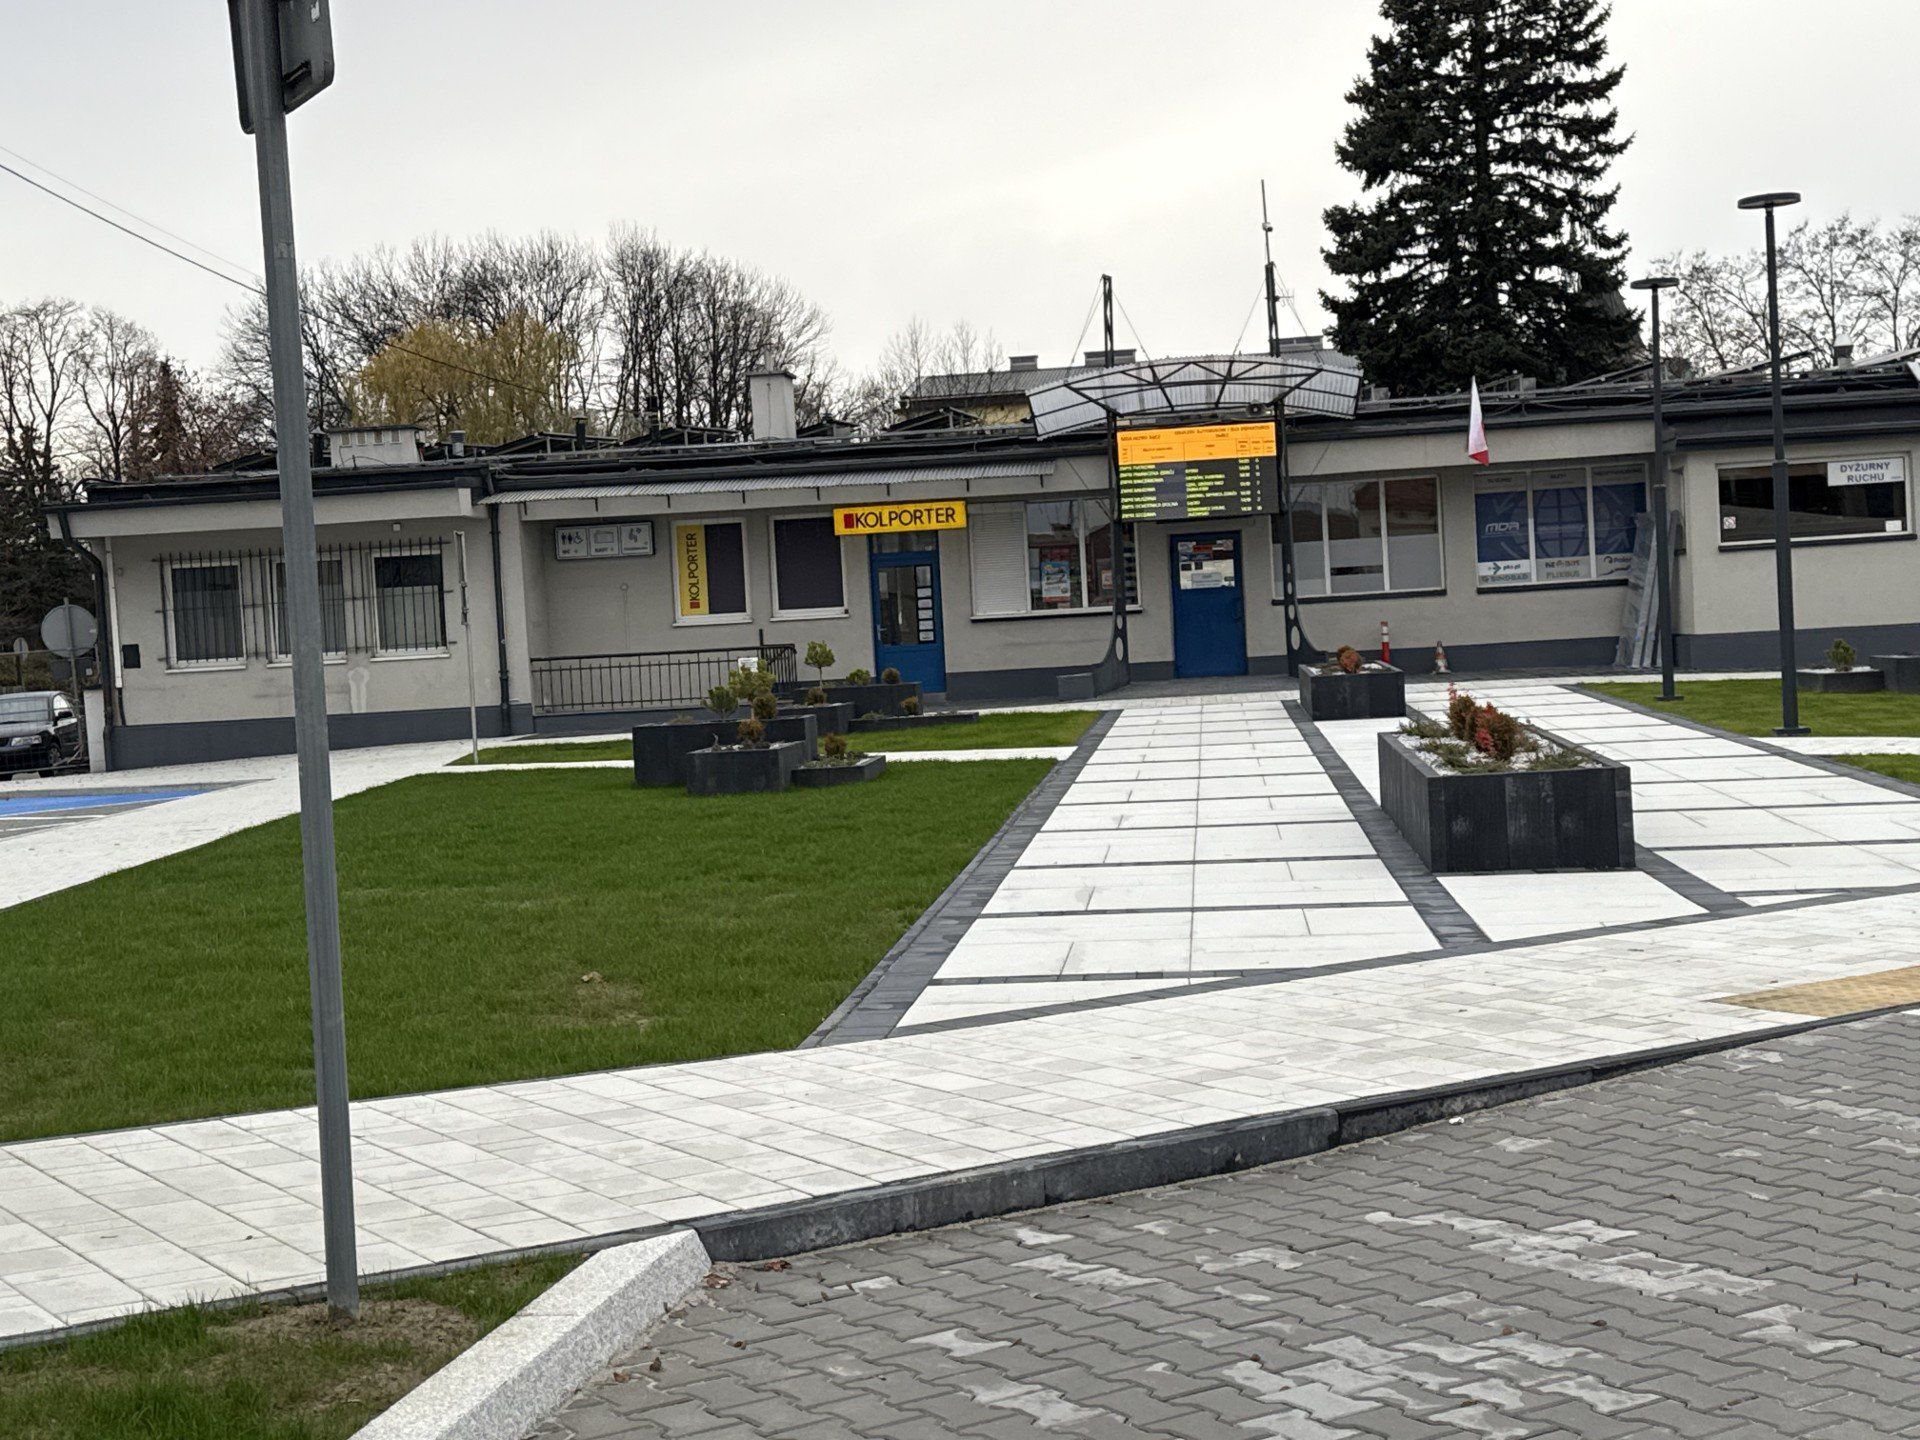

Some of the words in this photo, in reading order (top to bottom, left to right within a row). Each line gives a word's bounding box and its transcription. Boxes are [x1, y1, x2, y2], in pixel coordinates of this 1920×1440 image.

[1840, 461, 1890, 473] DYŻURNY
[1847, 473, 1885, 483] RUCHU
[855, 507, 957, 529] KOLPORTER
[686, 532, 700, 601] KOLPORTER
